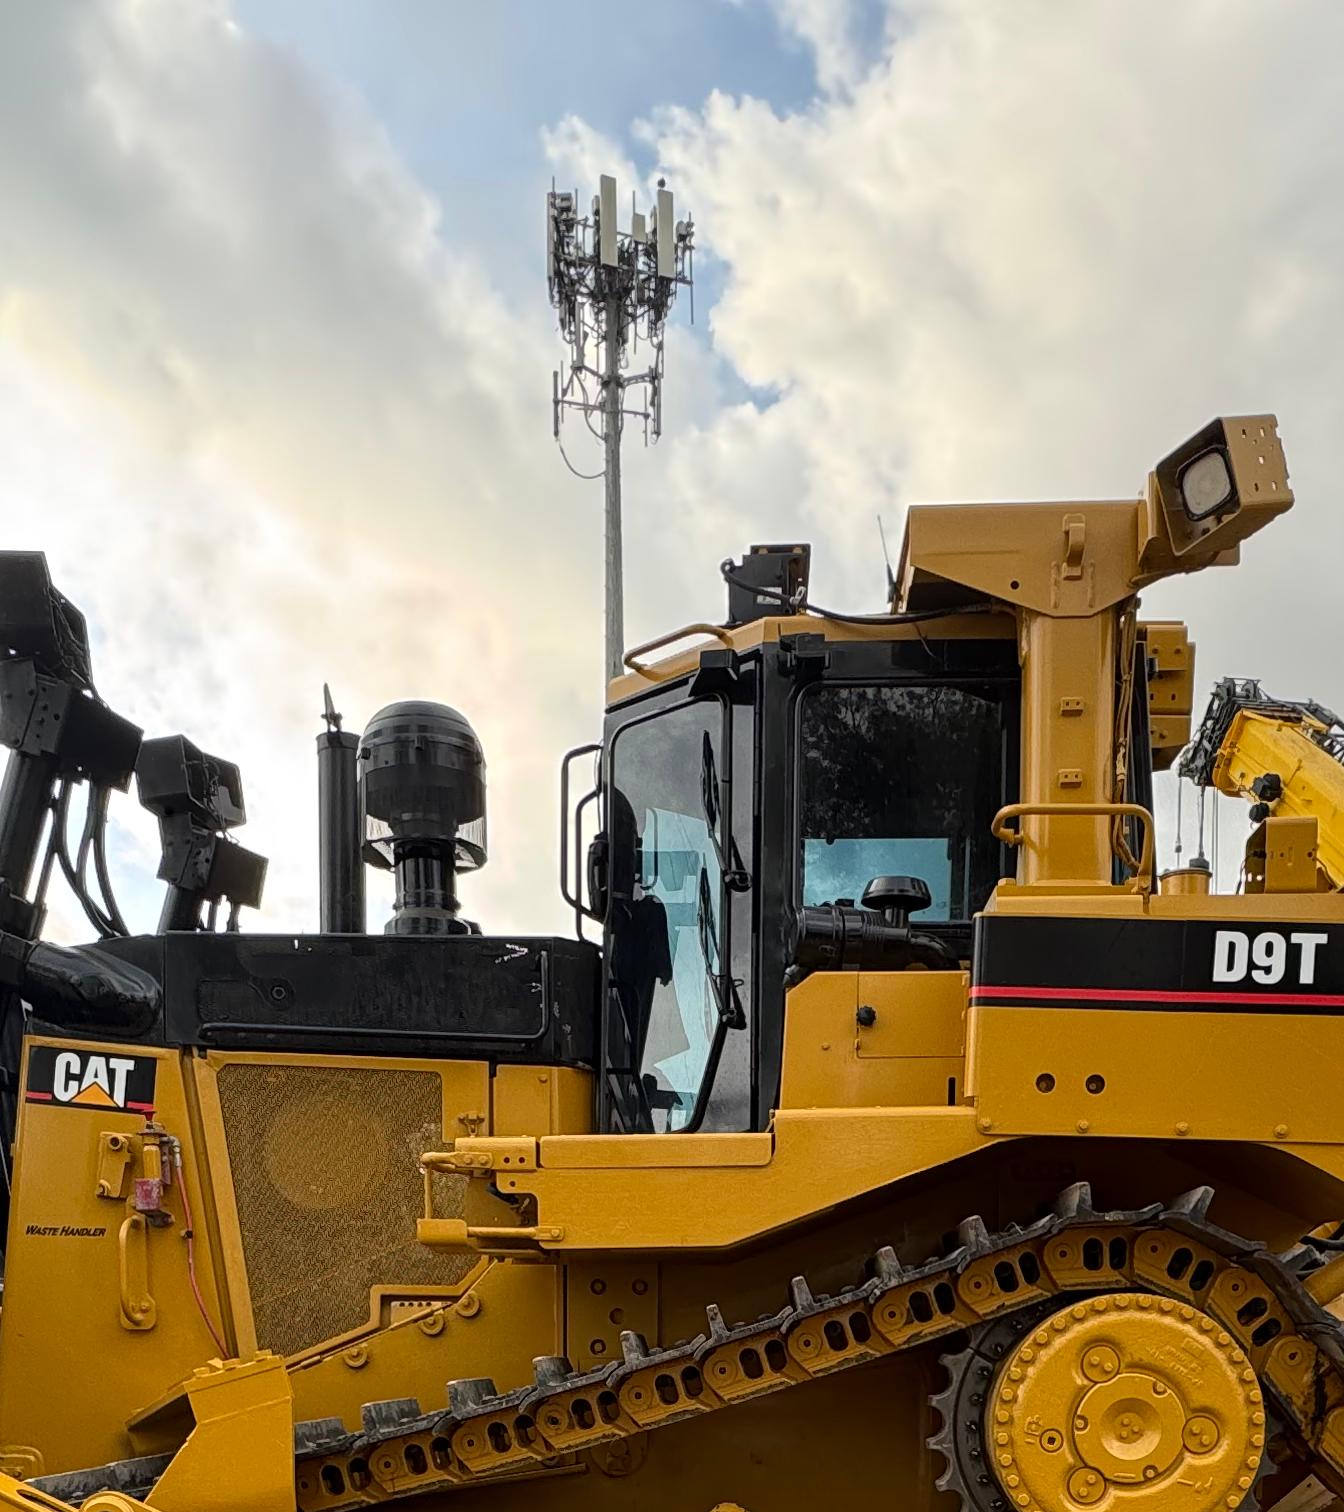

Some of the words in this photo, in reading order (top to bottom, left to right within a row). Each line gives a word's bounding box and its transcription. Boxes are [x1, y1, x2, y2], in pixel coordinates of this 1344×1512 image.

[1212, 930, 1329, 985] D9T
[53, 1052, 135, 1108] CAT
[26, 1225, 59, 1236] WASTE
[60, 1226, 106, 1237] HANDLER
